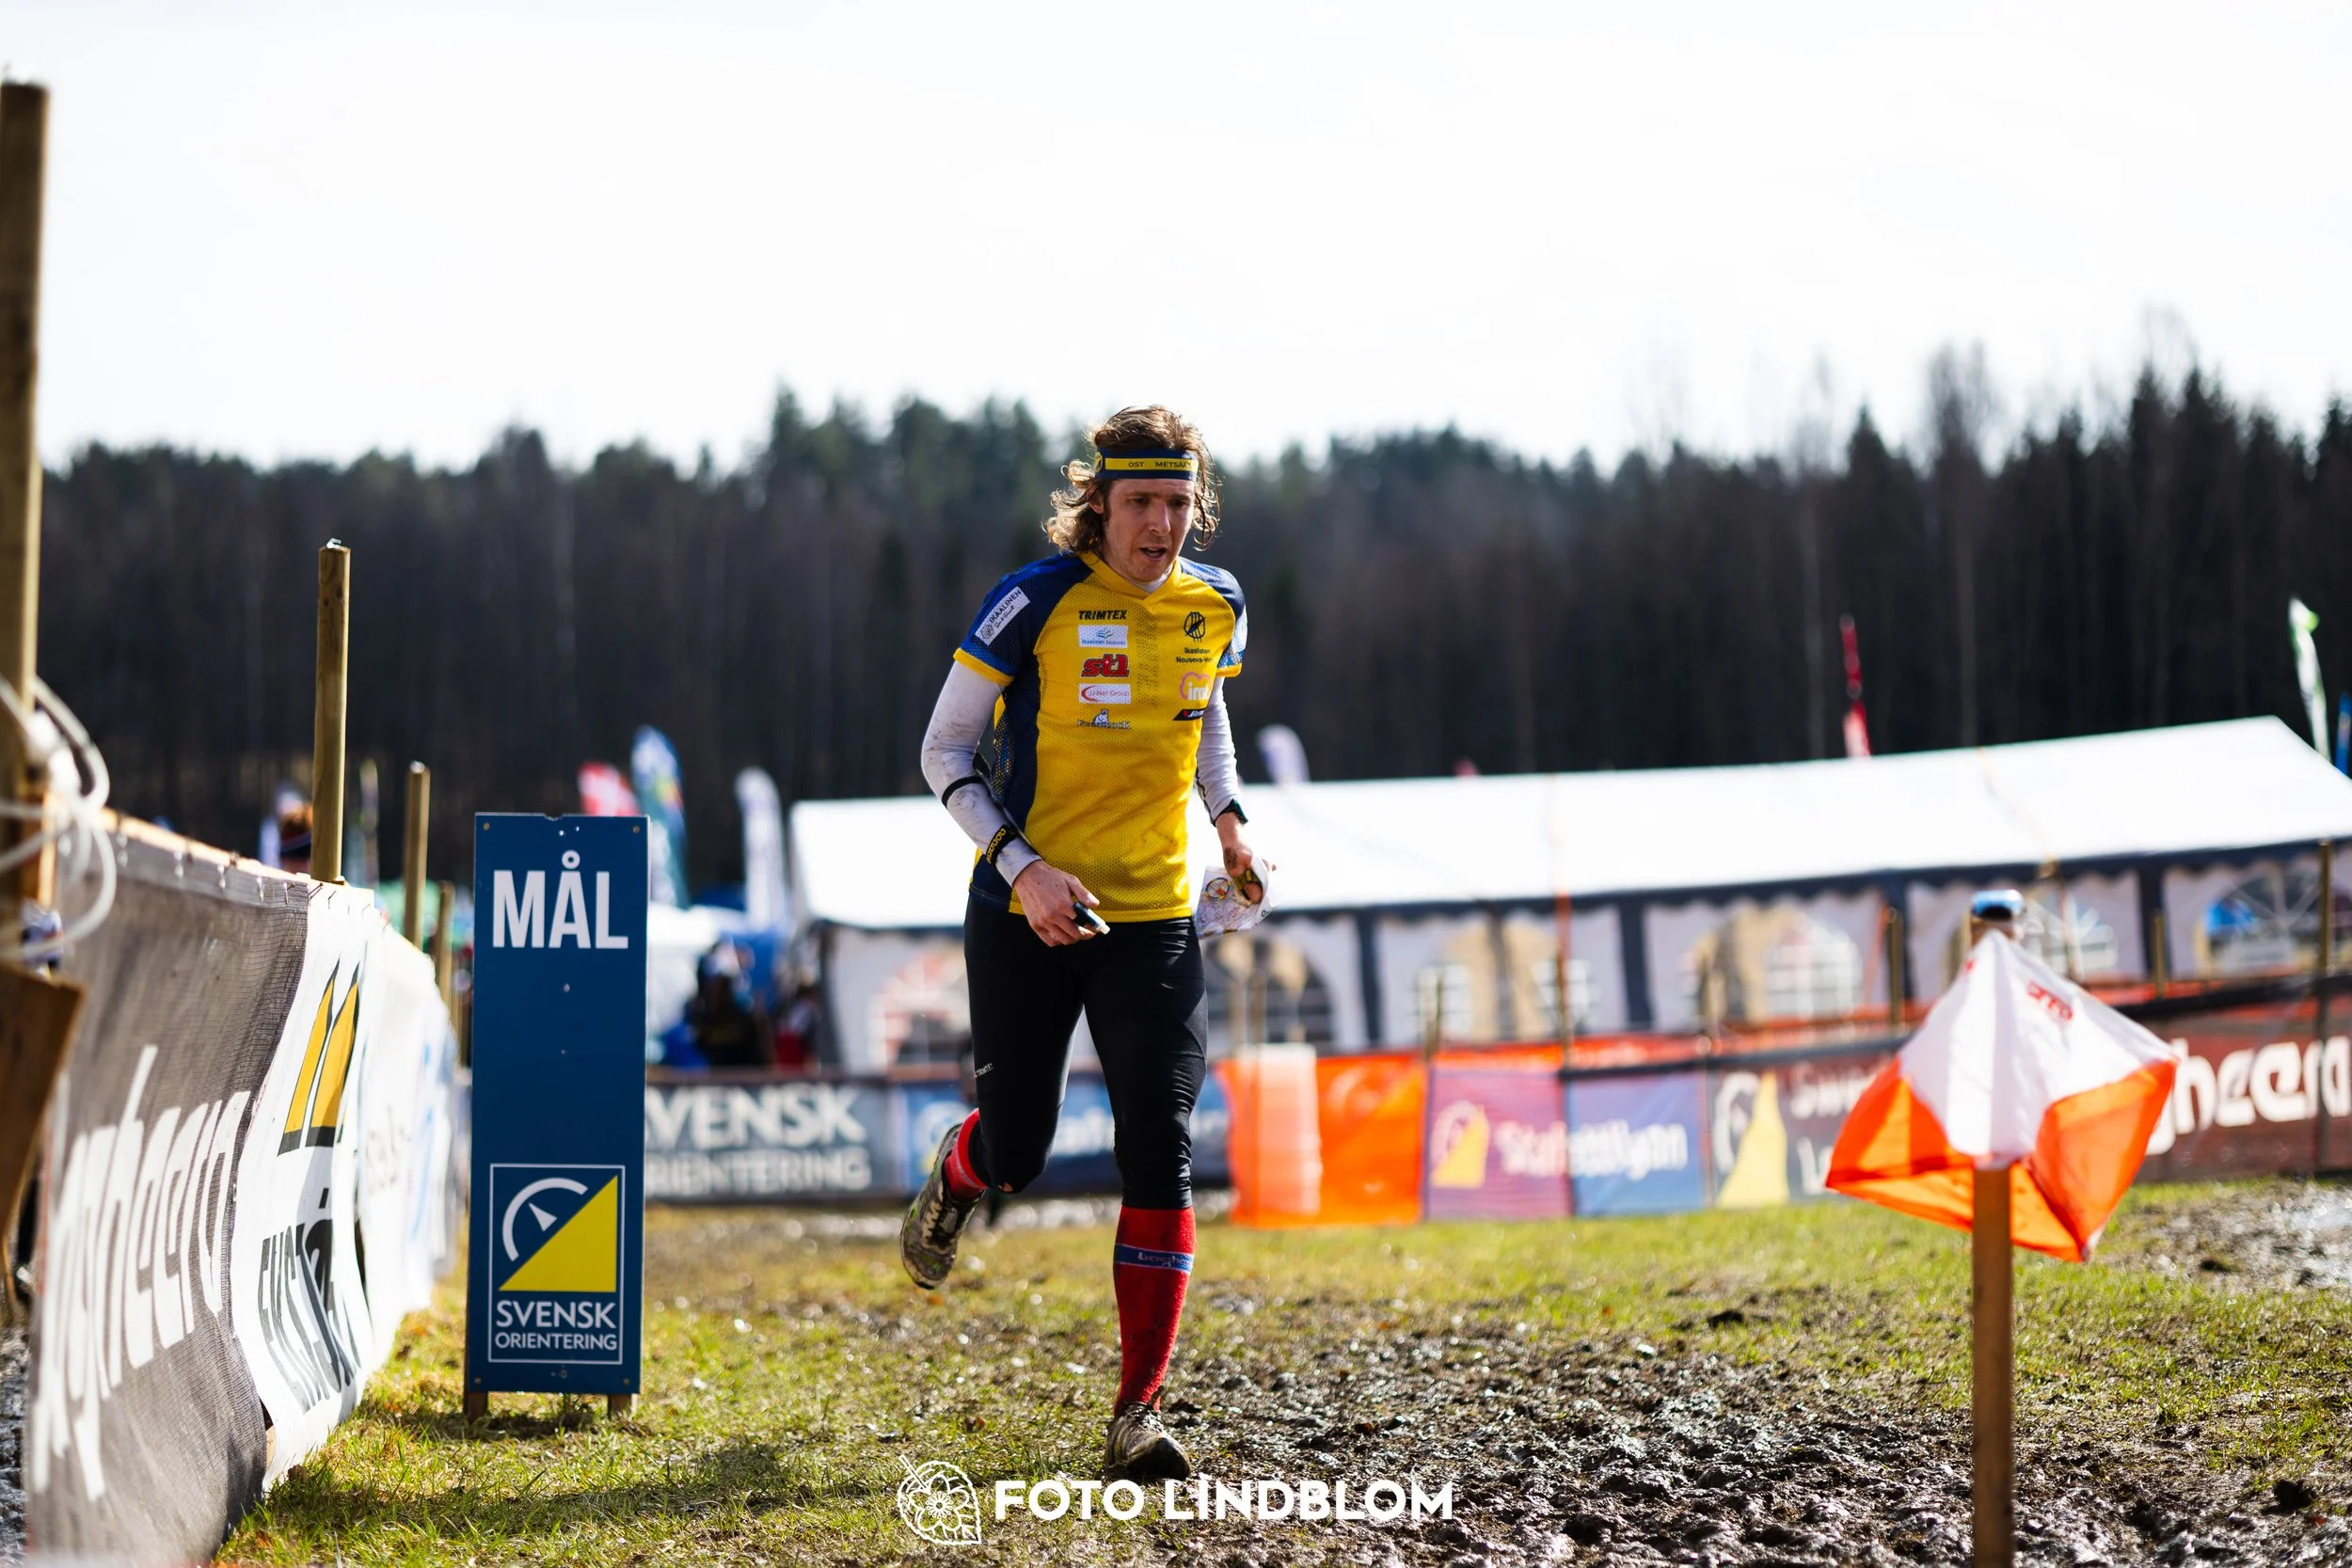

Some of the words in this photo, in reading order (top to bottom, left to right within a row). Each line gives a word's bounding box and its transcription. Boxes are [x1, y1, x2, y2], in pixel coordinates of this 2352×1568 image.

[989, 589, 1023, 624] IKAALINEN
[1078, 610, 1127, 621] TRIMTEX
[493, 849, 628, 949] MÅL
[645, 1084, 866, 1149] VENSK
[645, 1147, 872, 1197] RIENTERING
[496, 1300, 617, 1329] SVENSK
[495, 1331, 618, 1351] ORIENTERING
